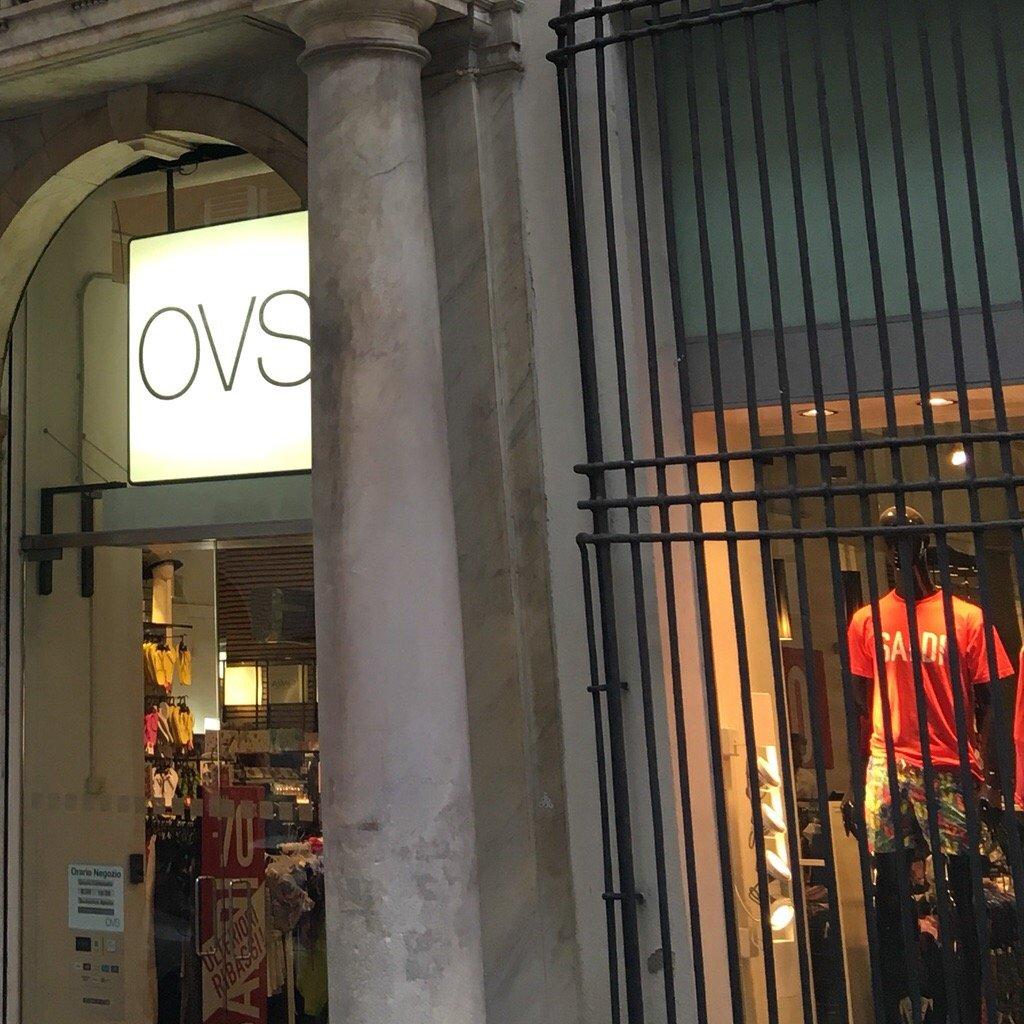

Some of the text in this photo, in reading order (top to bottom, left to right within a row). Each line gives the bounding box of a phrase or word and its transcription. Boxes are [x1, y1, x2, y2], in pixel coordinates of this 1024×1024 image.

[138, 289, 312, 401] OVS
[881, 630, 947, 667] SADI
[70, 866, 122, 879] Orario Negozio
